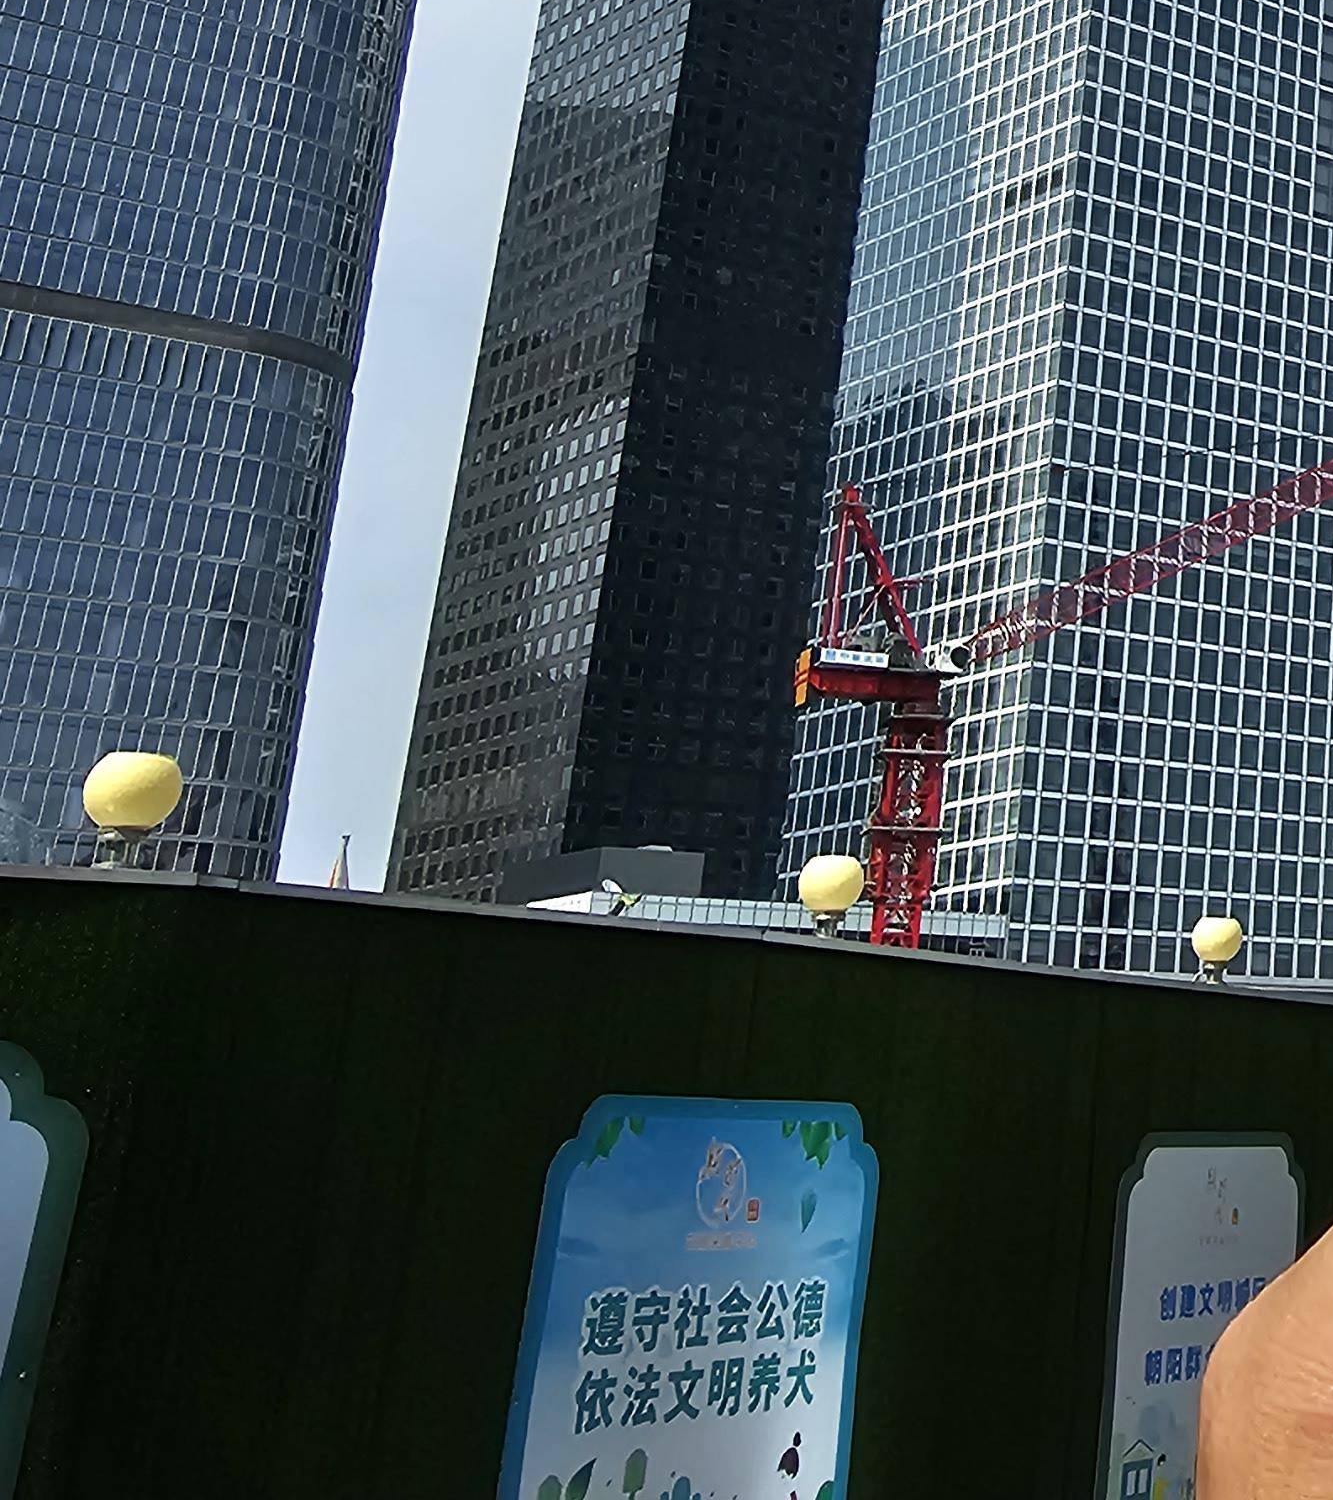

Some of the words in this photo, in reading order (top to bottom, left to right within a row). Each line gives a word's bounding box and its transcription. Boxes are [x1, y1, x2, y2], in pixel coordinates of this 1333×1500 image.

[582, 1278, 827, 1358] 遵守社会公德
[573, 1349, 818, 1436] 依法文明养犬
